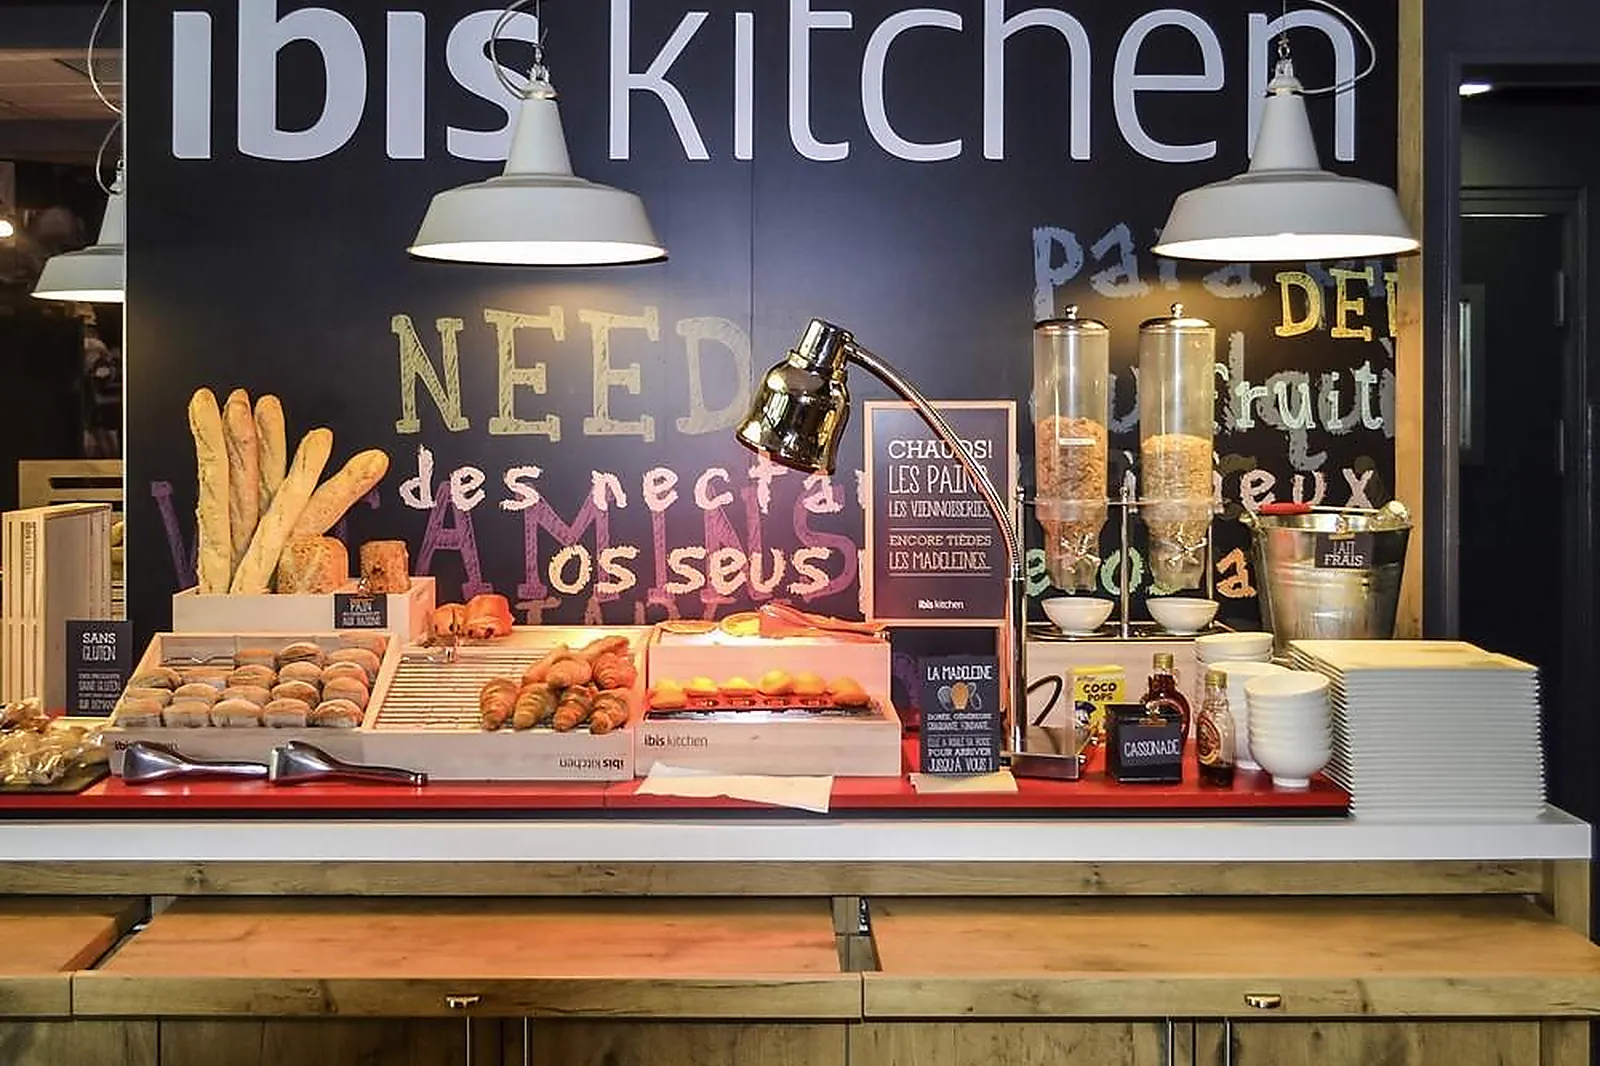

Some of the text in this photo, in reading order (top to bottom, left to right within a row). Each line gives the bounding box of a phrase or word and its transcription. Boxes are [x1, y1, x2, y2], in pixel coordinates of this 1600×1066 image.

[172, 0, 1356, 162] ibis kitchen
[391, 305, 754, 442] NEED
[400, 444, 541, 511] des
[889, 465, 987, 494] LES PAIN
[889, 501, 907, 518] LES
[890, 533, 991, 546] ENCORE TIÈDES
[889, 551, 909, 569] LES
[1324, 554, 1364, 566] FRAIS
[666, 546, 831, 594] seus
[918, 600, 964, 609] ibis kitchen
[82, 632, 116, 644] SANS
[927, 665, 941, 680] LA
[1083, 682, 1117, 694] COCO
[644, 734, 708, 747] ibis kitchen
[1124, 739, 1181, 757] CASSONADE
[559, 757, 624, 768] ibis kitchen
